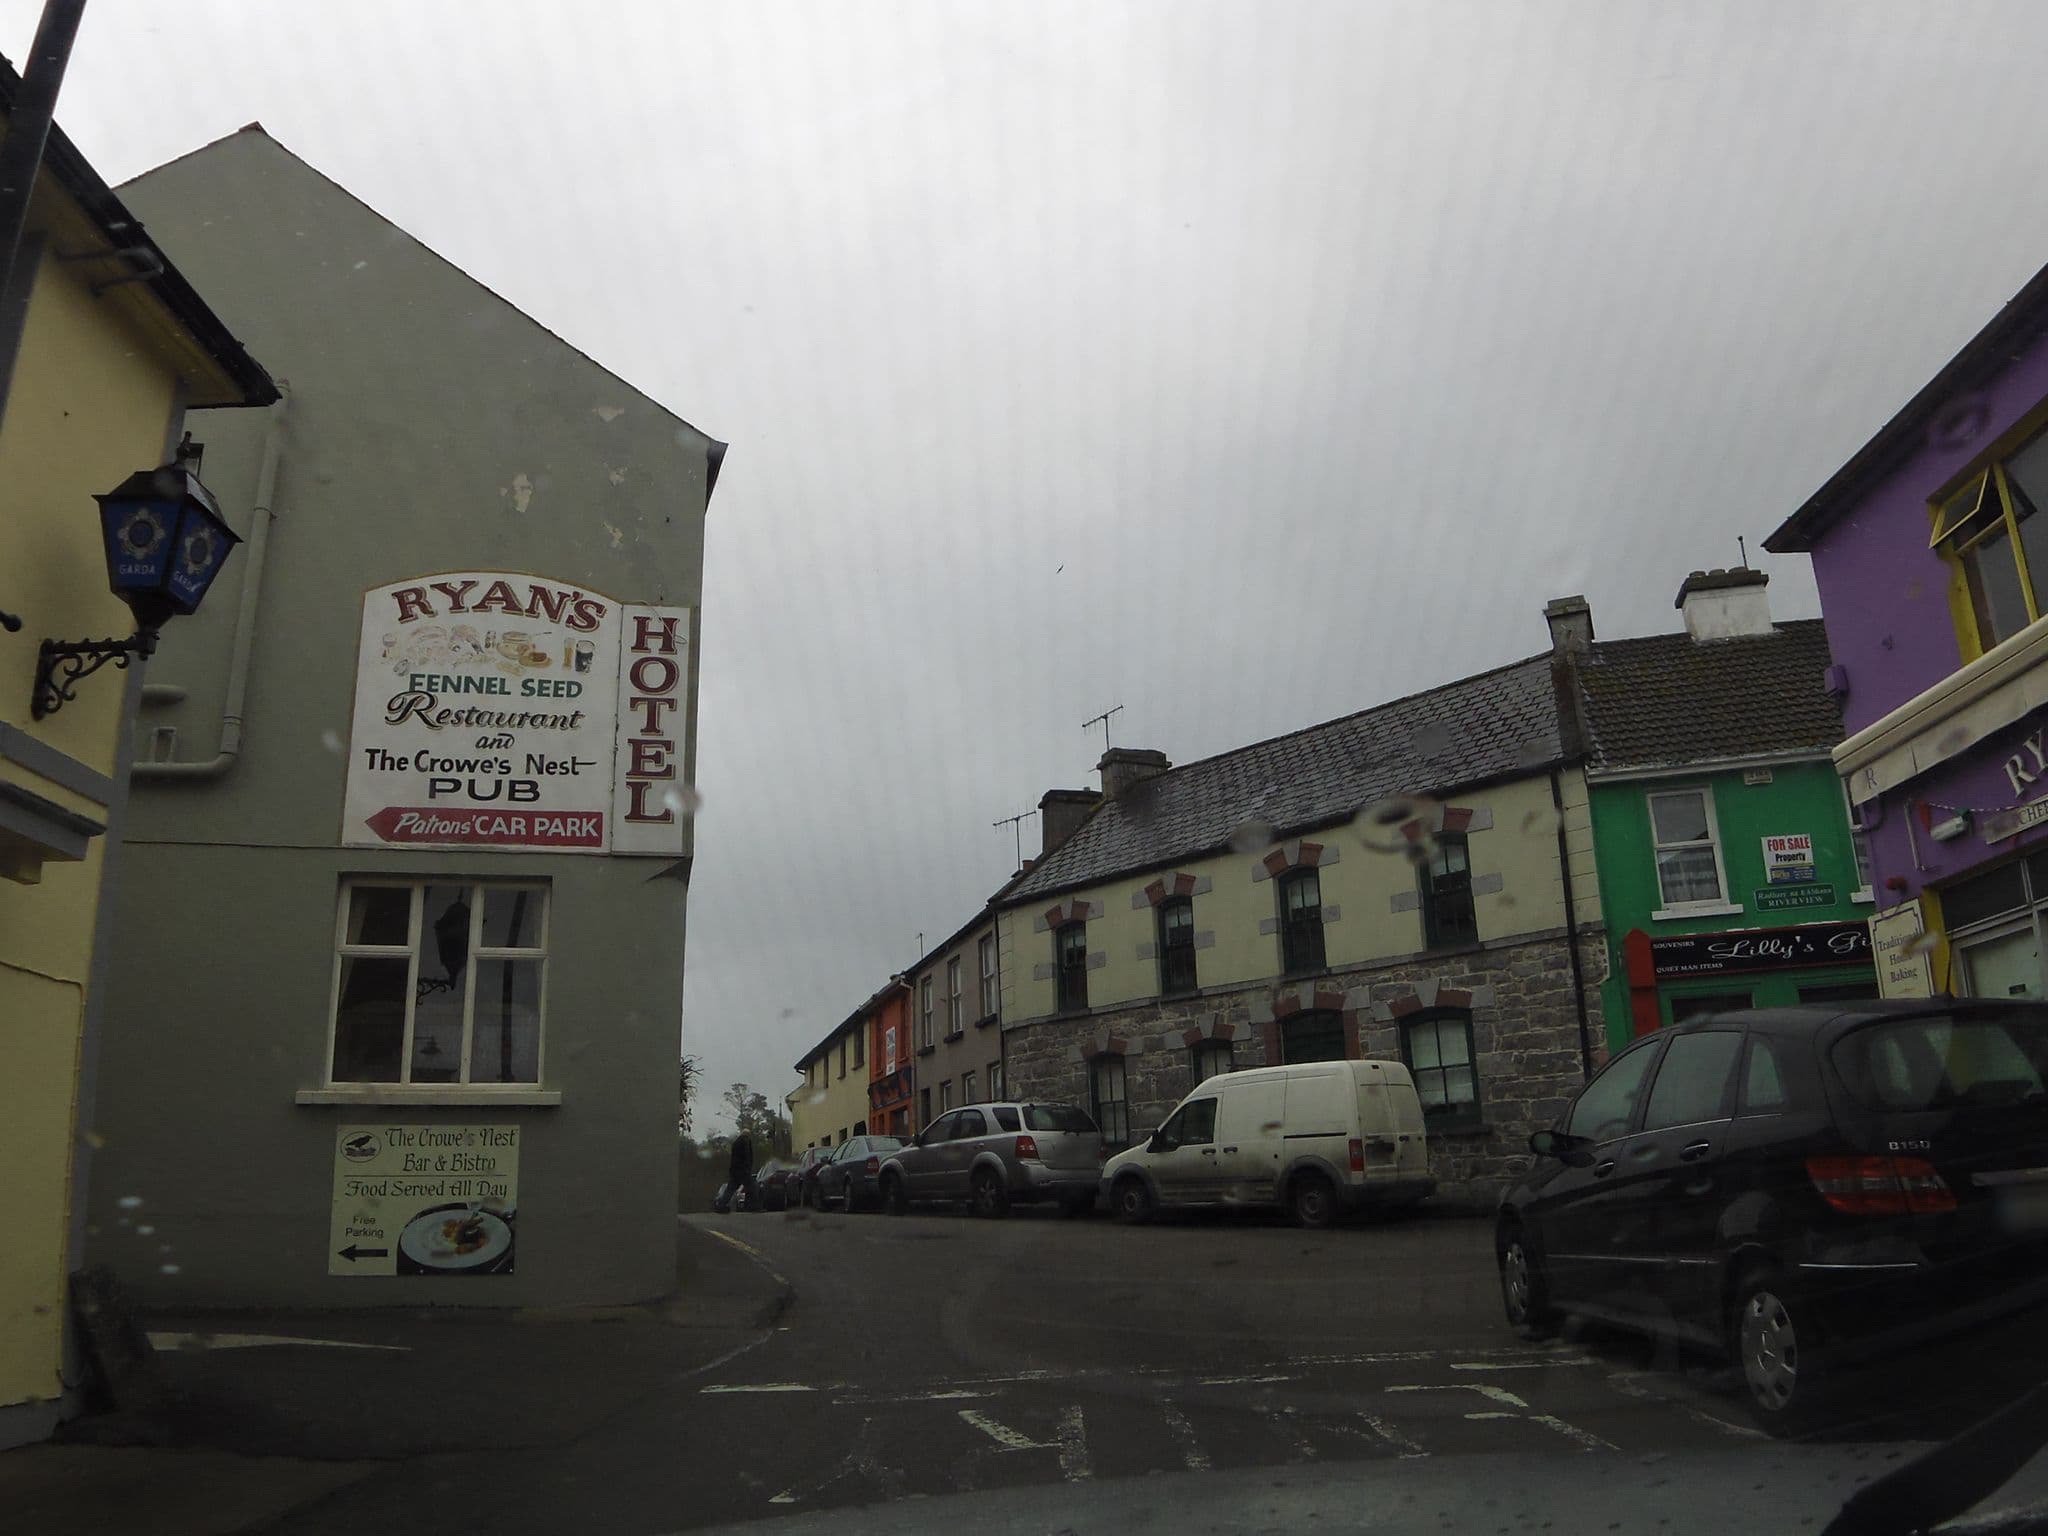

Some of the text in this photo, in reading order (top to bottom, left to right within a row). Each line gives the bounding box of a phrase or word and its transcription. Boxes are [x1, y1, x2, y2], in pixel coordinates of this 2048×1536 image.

[119, 564, 156, 576] GARDA
[391, 579, 607, 633] RYAN'S
[408, 673, 584, 699] FENNEL SEED
[384, 690, 586, 731] Restaurant
[624, 615, 680, 825] HOTEL
[475, 733, 516, 750] and
[365, 748, 598, 776] The Crowe's Nest
[428, 777, 541, 803] PUB
[474, 815, 527, 837] CAR
[533, 817, 600, 838] PARK
[1767, 836, 1810, 851] FOR SALE
[1775, 852, 1806, 863] Property
[1653, 940, 1695, 950] SOUVENIRS
[1707, 931, 1873, 960] Lilly's Gi
[1656, 961, 1723, 974] QUIET MAN ITEMS
[384, 1127, 517, 1147] The Crowe's Nest
[402, 1152, 496, 1172] Bar & Bistro
[344, 1180, 508, 1199] Food Served All Day
[352, 1215, 376, 1225] Free
[345, 1227, 384, 1239] Parking
